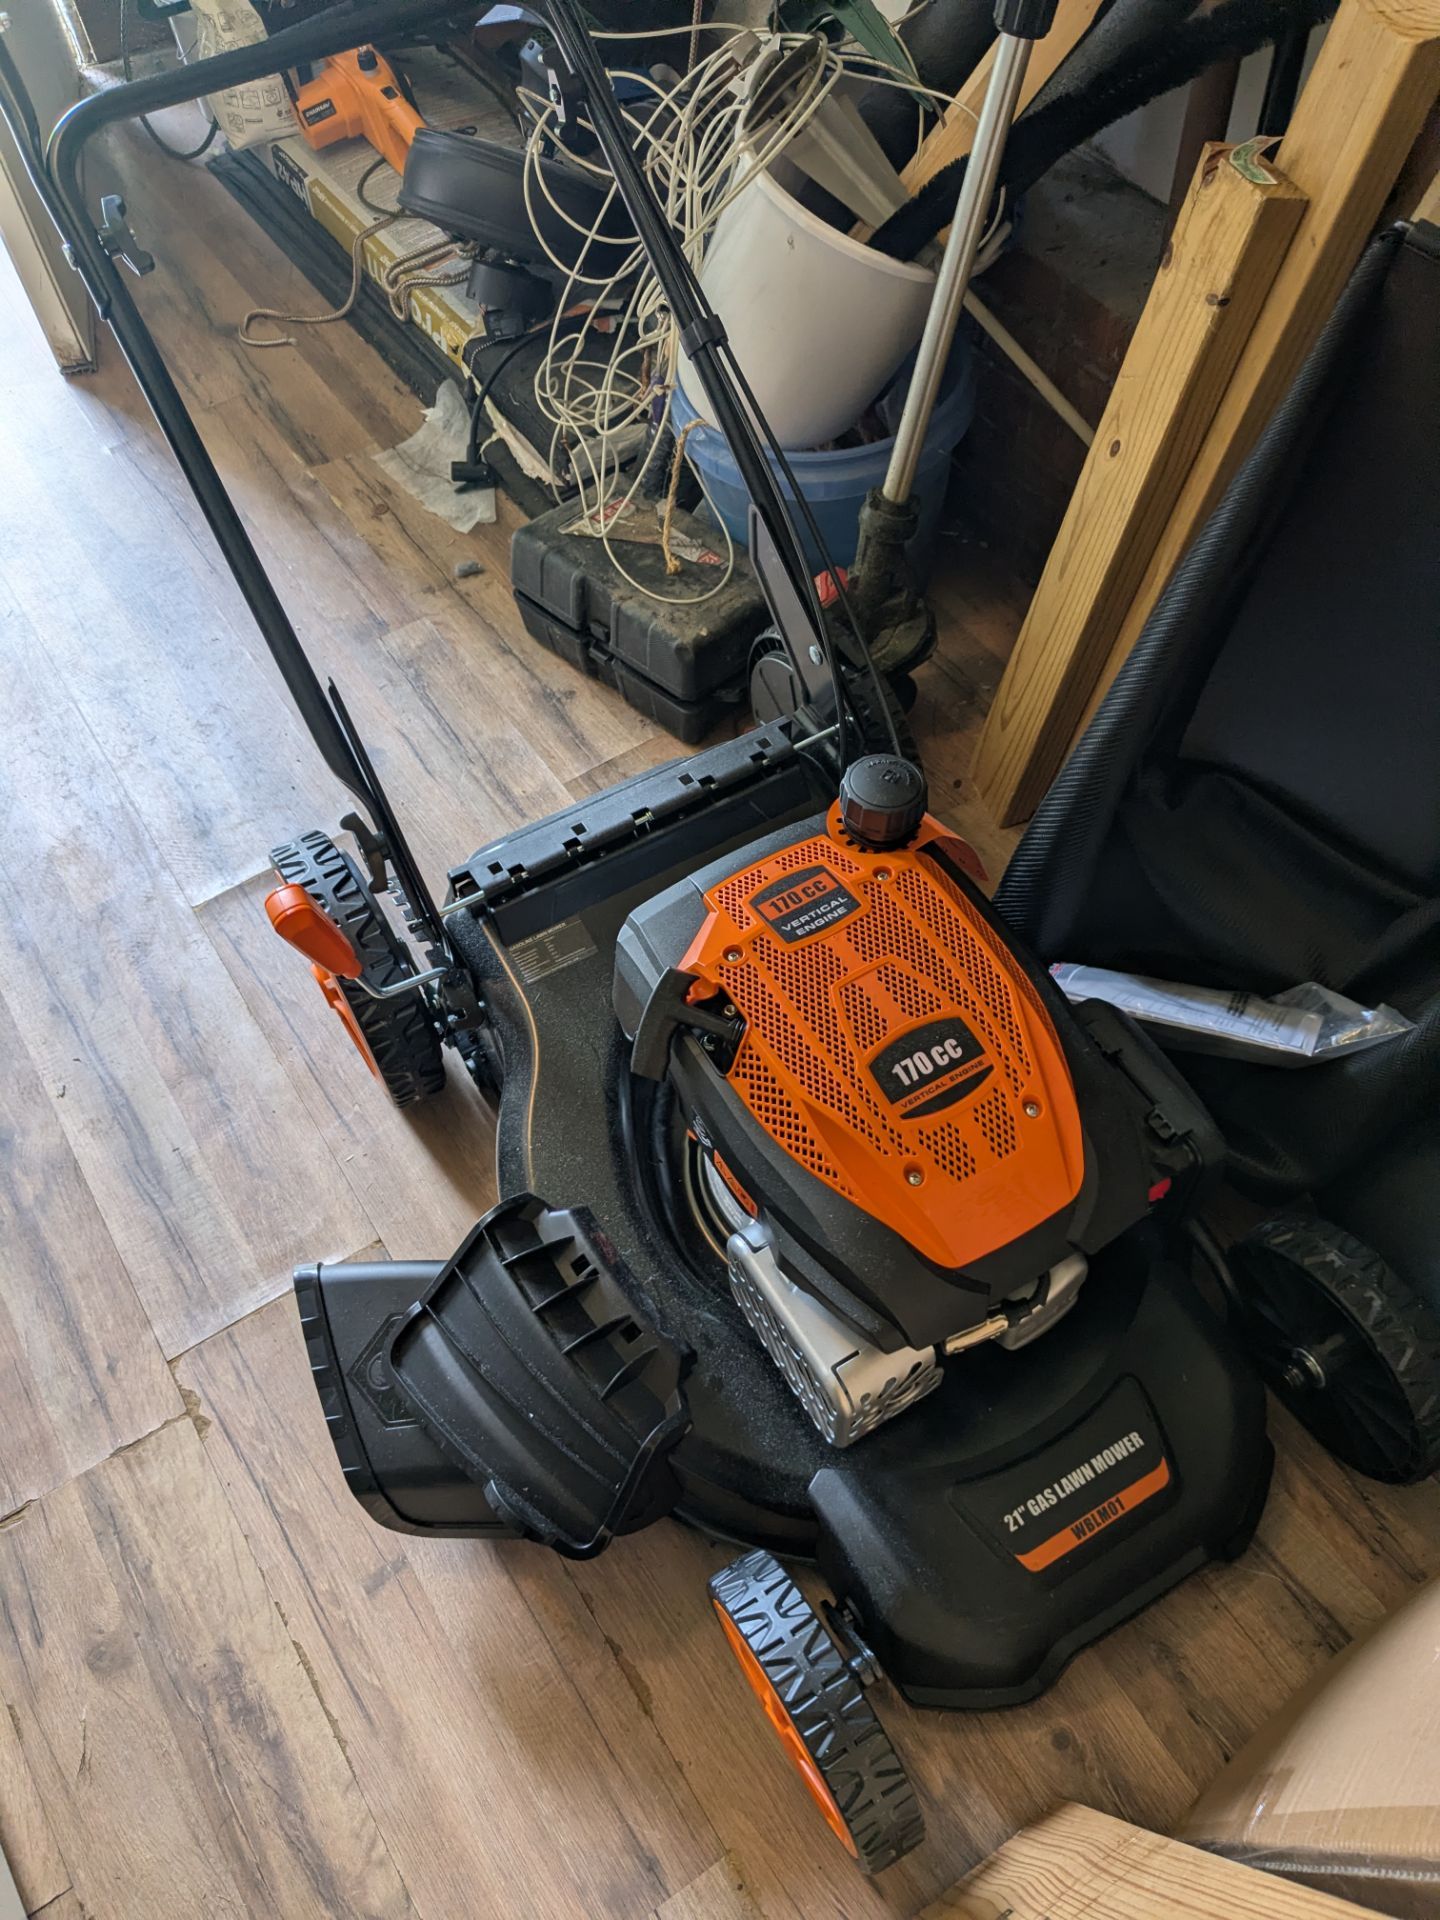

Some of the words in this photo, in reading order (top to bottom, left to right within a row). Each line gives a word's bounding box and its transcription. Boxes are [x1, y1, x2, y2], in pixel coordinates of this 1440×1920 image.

[769, 891, 803, 914] 170
[801, 880, 827, 898] CC
[781, 896, 848, 931] VERTICAL
[796, 906, 848, 936] ENGINE
[892, 1051, 934, 1086] 170
[930, 1038, 963, 1066] CC
[901, 1081, 948, 1109] VERTICAL
[949, 1060, 984, 1082] ENGINE
[1003, 1505, 1027, 1532] 21"
[1026, 1488, 1058, 1517] GAS
[1053, 1463, 1095, 1498] LAWN
[1090, 1431, 1145, 1475] MOWER
[1070, 1497, 1126, 1541] WBLM01
